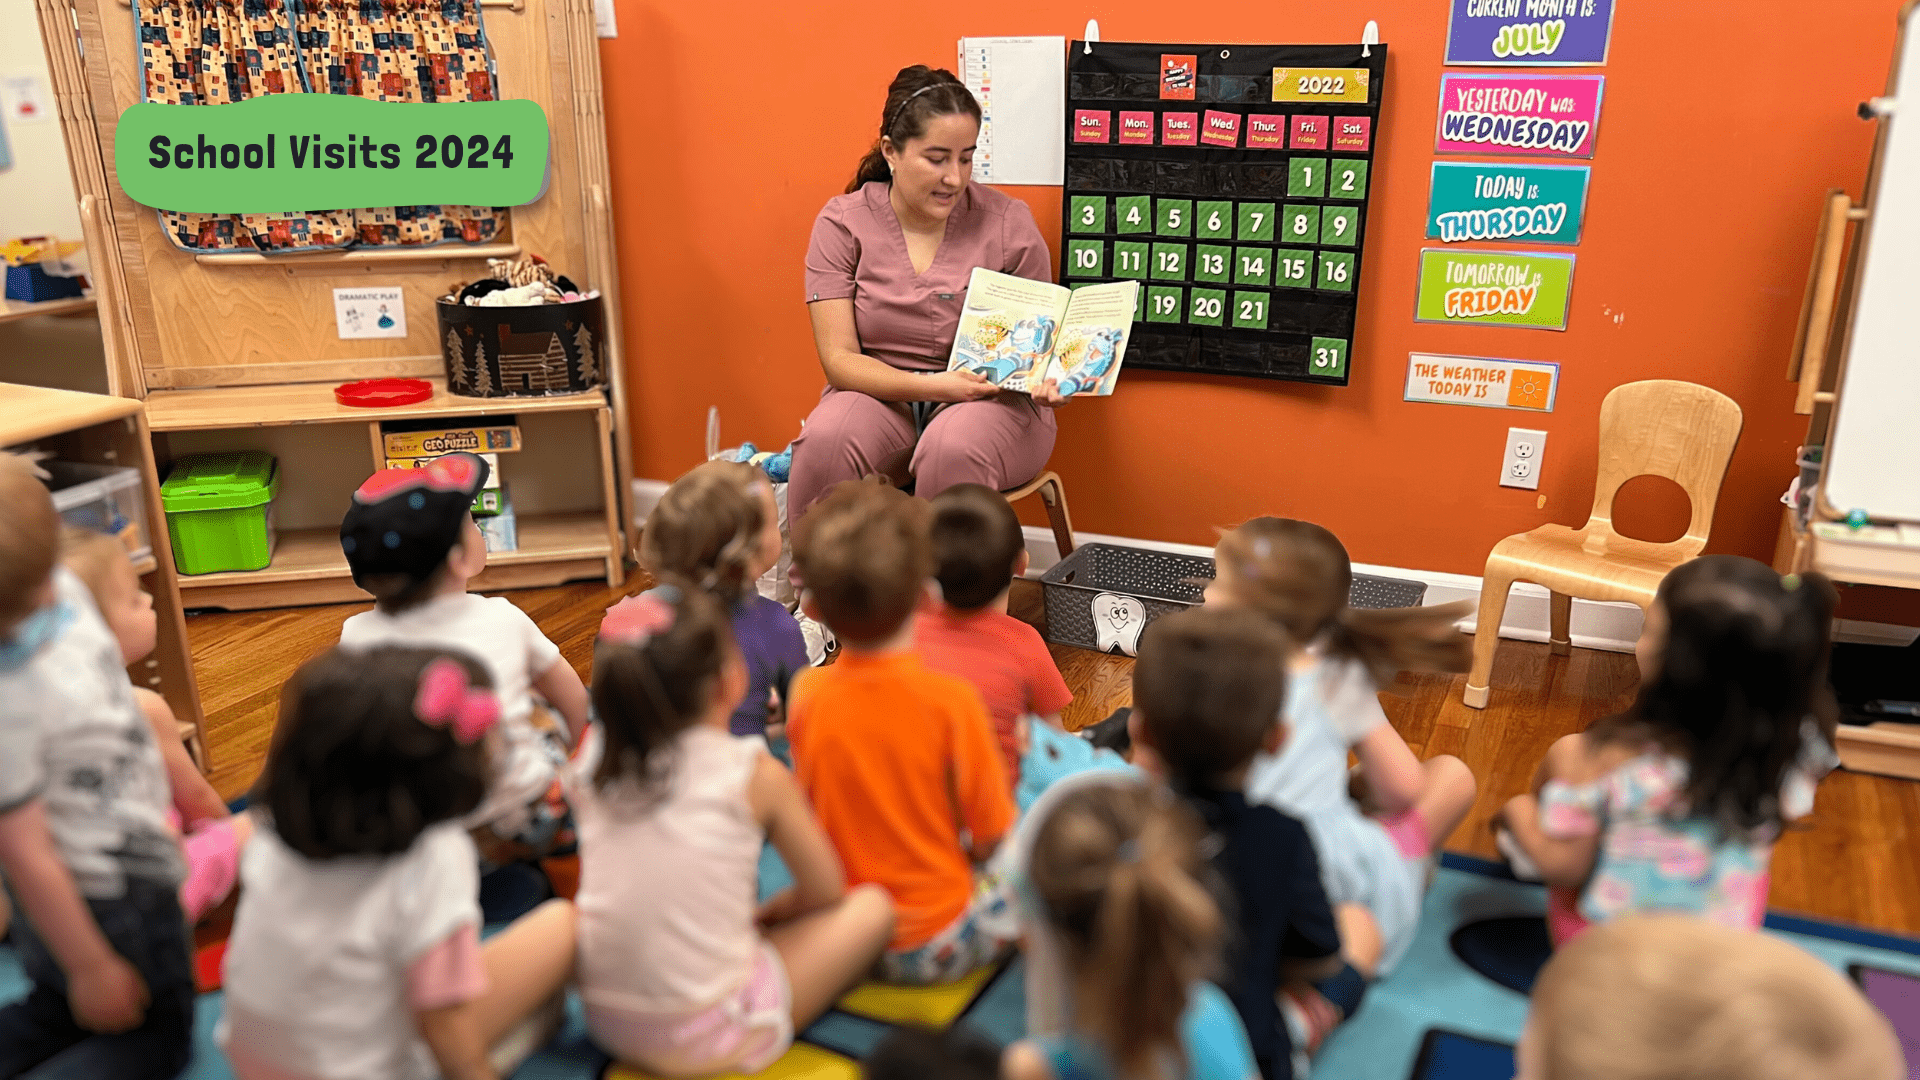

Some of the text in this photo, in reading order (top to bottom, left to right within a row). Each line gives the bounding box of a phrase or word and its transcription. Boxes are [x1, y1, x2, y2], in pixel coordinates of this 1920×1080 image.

[1467, 0, 1597, 18] CURRENT MONTH IS:
[1495, 22, 1562, 54] JULY
[1297, 76, 1345, 94] 2022
[1457, 87, 1576, 113] YESTERDAY WAS:
[1080, 116, 1362, 134] Sun. Mon. Tues. Wed. Thur. Fri. Sat.
[1445, 113, 1586, 149] WEDNESDAY
[1079, 130, 1364, 146] Sunday Monday Tuesday Wednesday Thursday Friday Saturday
[1303, 167, 1355, 191] 1 2
[1475, 175, 1540, 199] TODAY IS:
[1081, 205, 1347, 237] 3 4 5 6 7 8 9
[1439, 204, 1564, 239] THURSDAY
[1074, 249, 1347, 283] 10 11 12 13 14 15 16
[1446, 261, 1530, 286] TOMORROW
[338, 292, 399, 301] DRAMATIC PLAY
[1154, 295, 1176, 315] 19
[1194, 297, 1221, 318] 20
[1239, 301, 1263, 321] 21
[1447, 287, 1535, 314] FRIDAY
[1315, 347, 1337, 368] 31
[1414, 363, 1506, 384] THE WEATHER
[1428, 381, 1488, 398] TODAY IS
